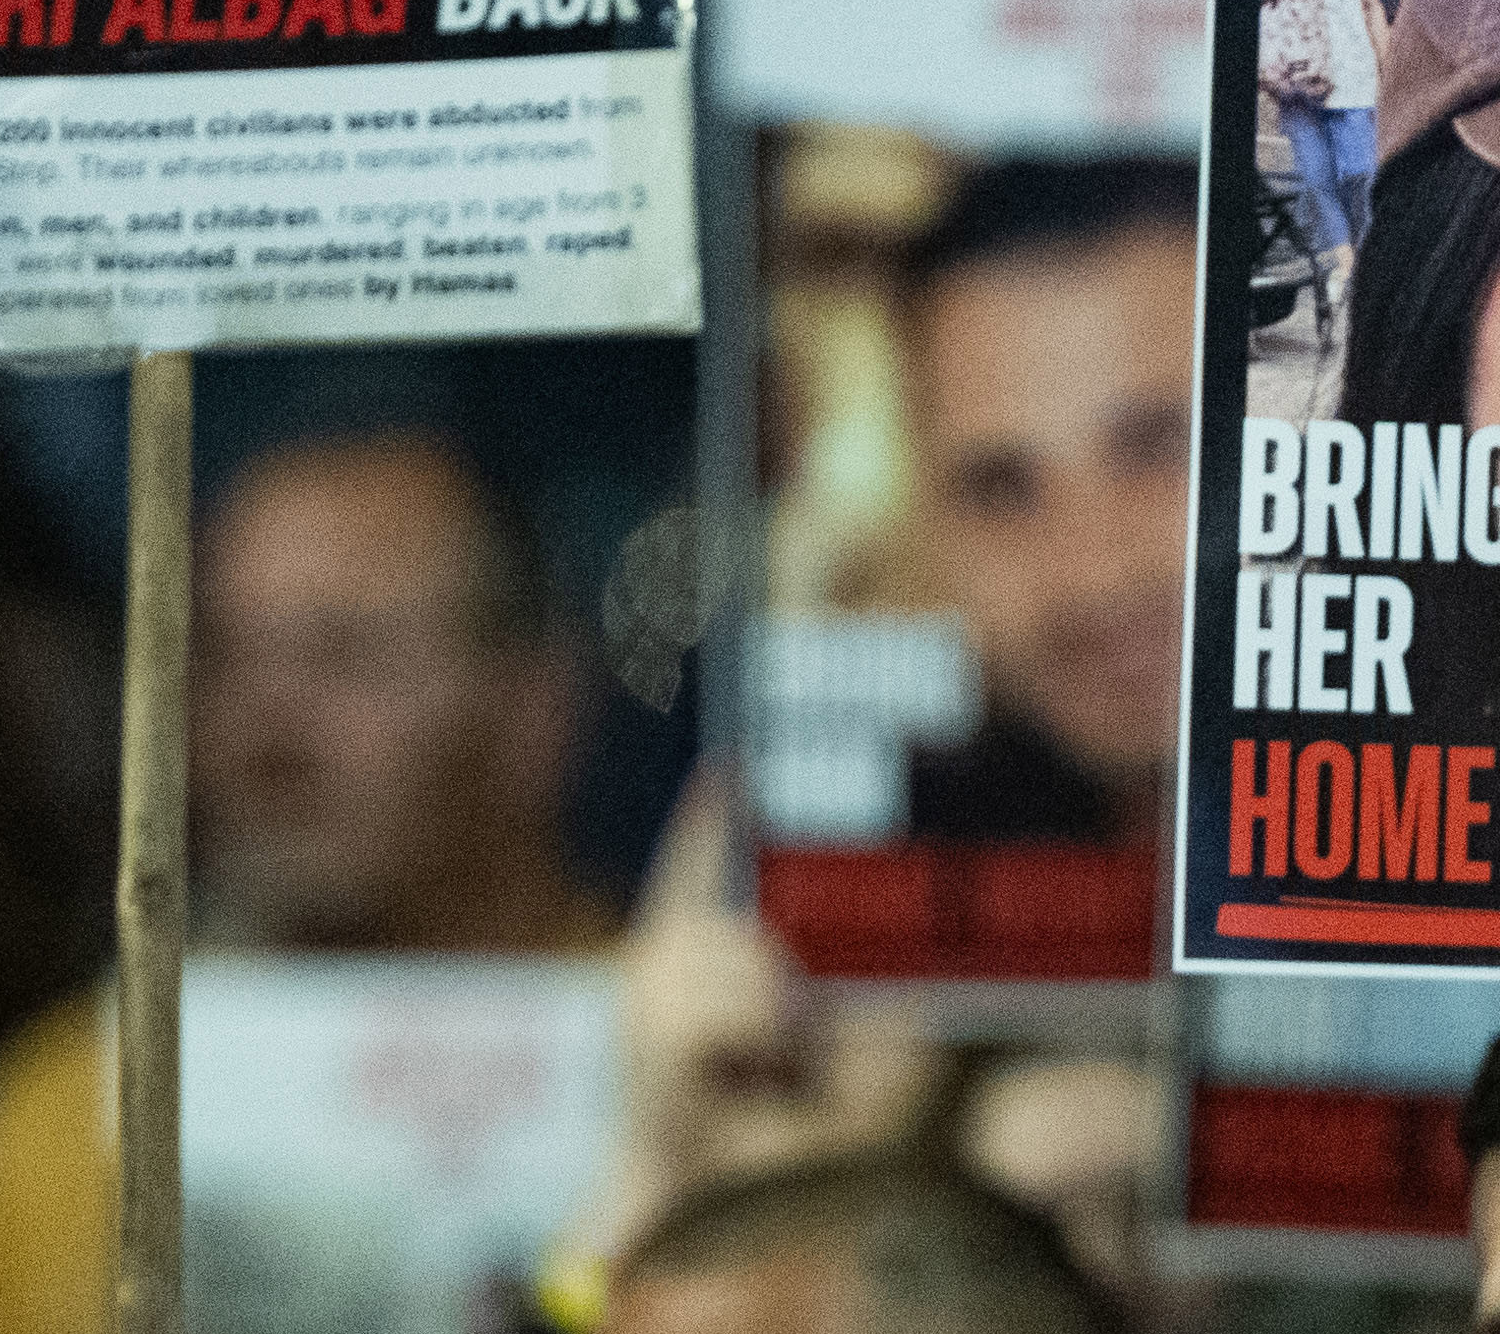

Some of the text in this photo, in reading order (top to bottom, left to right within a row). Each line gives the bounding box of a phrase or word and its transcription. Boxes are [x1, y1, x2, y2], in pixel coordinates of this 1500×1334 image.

[61, 115, 196, 142] innocent
[206, 109, 334, 137] civilians
[345, 109, 418, 133] were
[427, 97, 571, 128] abducted
[125, 206, 184, 234] and
[364, 272, 400, 303] by
[1232, 569, 1415, 715] HER
[1228, 738, 1497, 885] HOME
